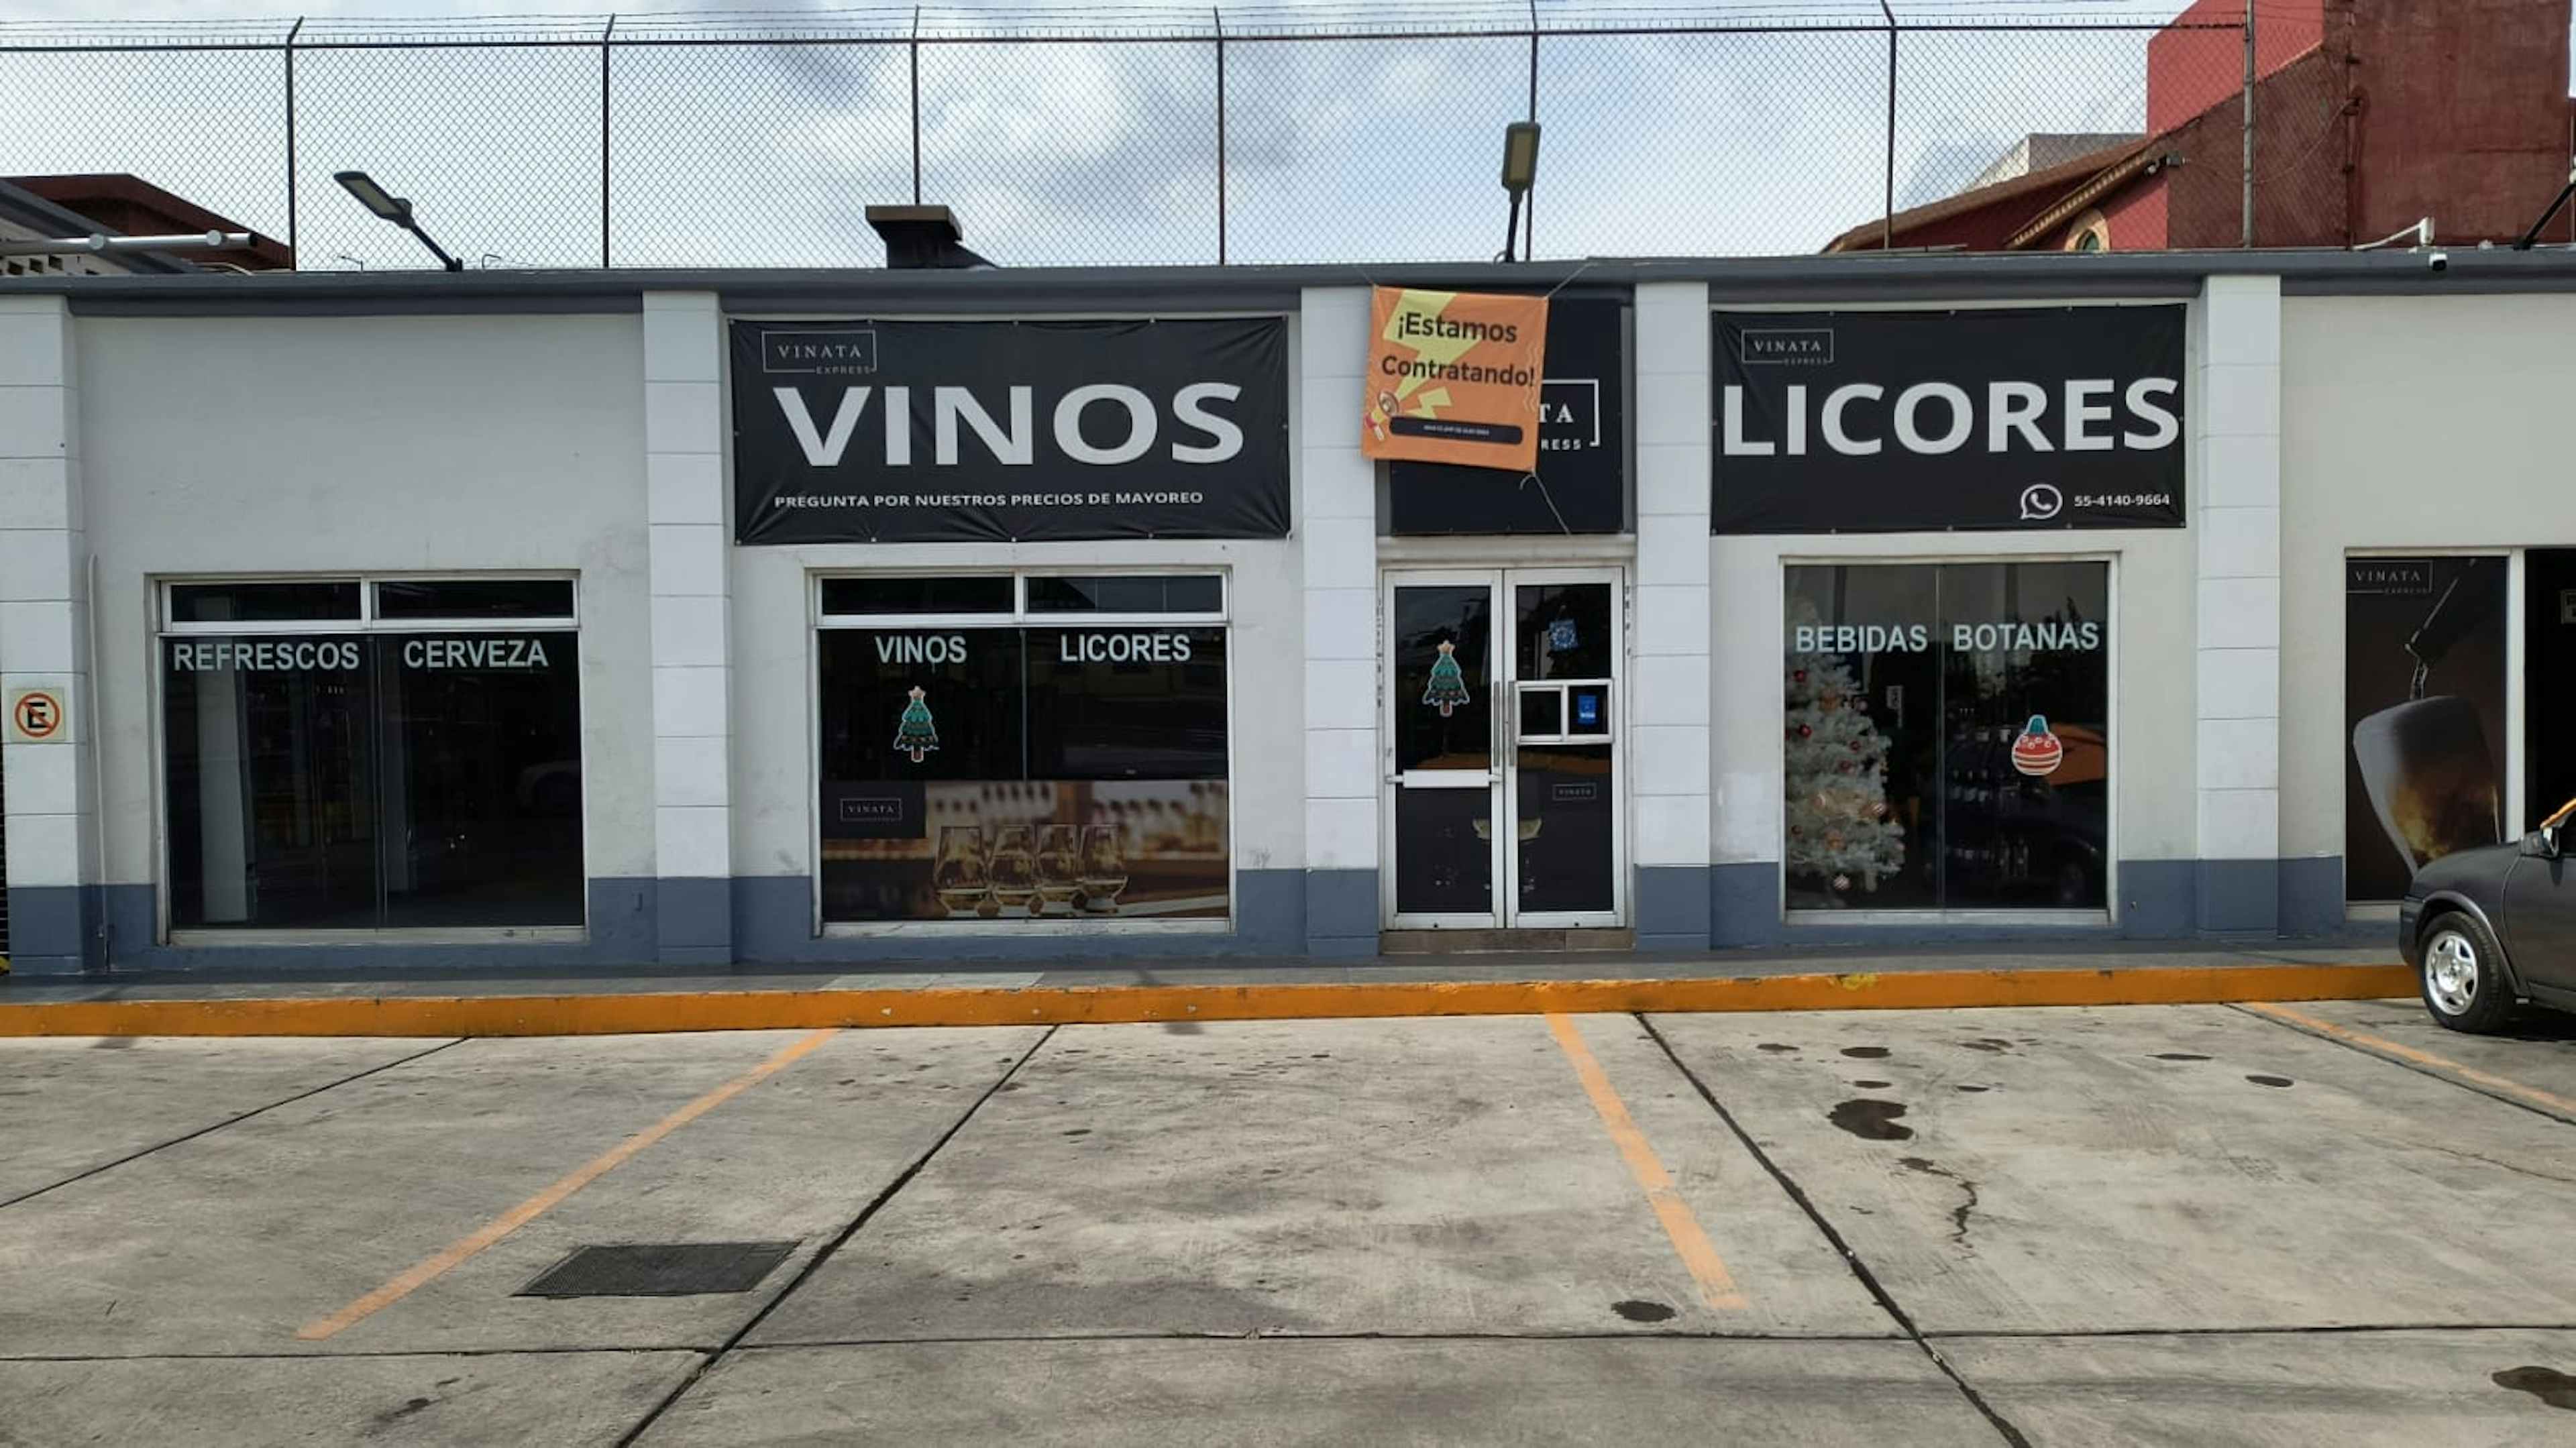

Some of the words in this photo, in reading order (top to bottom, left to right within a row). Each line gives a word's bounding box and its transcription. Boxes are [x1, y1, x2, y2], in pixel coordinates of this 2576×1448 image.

[1397, 312, 1517, 343] ¡Estamos
[778, 345, 862, 359] VINATA
[1754, 340, 1821, 352] VINATA
[1382, 355, 1536, 387] Contratando!
[772, 382, 1244, 467] VINOS
[1723, 378, 2180, 457] LICORES
[1541, 438, 1582, 451] RESS
[774, 494, 870, 508] PREGUNTA
[873, 494, 910, 507] POR
[914, 494, 1006, 506] NUESTROS
[1011, 493, 1083, 506] PRECIOS
[1088, 492, 1111, 504] DE
[1115, 492, 1203, 504] MAYOREO
[2074, 494, 2170, 507] 55-4140-9664
[2355, 570, 2421, 581] VINATA
[875, 635, 967, 664] VINOS
[1061, 633, 1191, 663] LICORES
[1795, 624, 1928, 653] BEBIDAS
[1953, 622, 2099, 652] BOTANAS
[174, 641, 360, 671] REFRESCOS
[404, 639, 549, 669] CERVEZA
